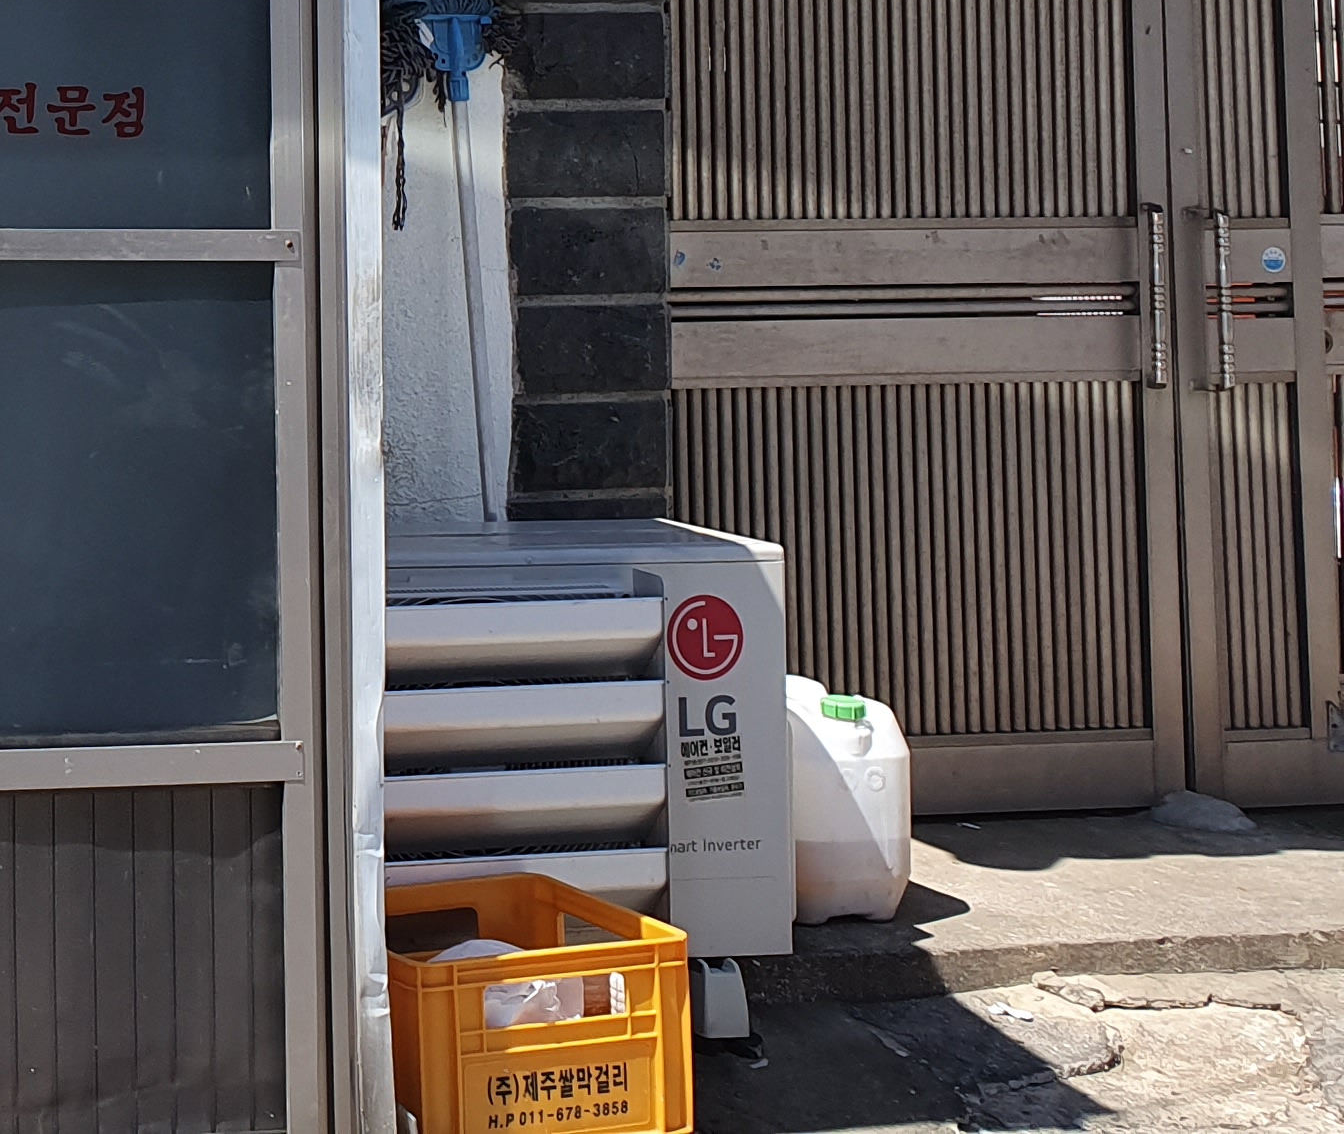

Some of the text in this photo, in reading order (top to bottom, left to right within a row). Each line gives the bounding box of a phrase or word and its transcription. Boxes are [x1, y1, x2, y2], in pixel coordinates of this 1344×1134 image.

[678, 695, 737, 737] LG
[703, 838, 762, 852] Inverter
[488, 1100, 629, 1129] H.P 011-678-3858
